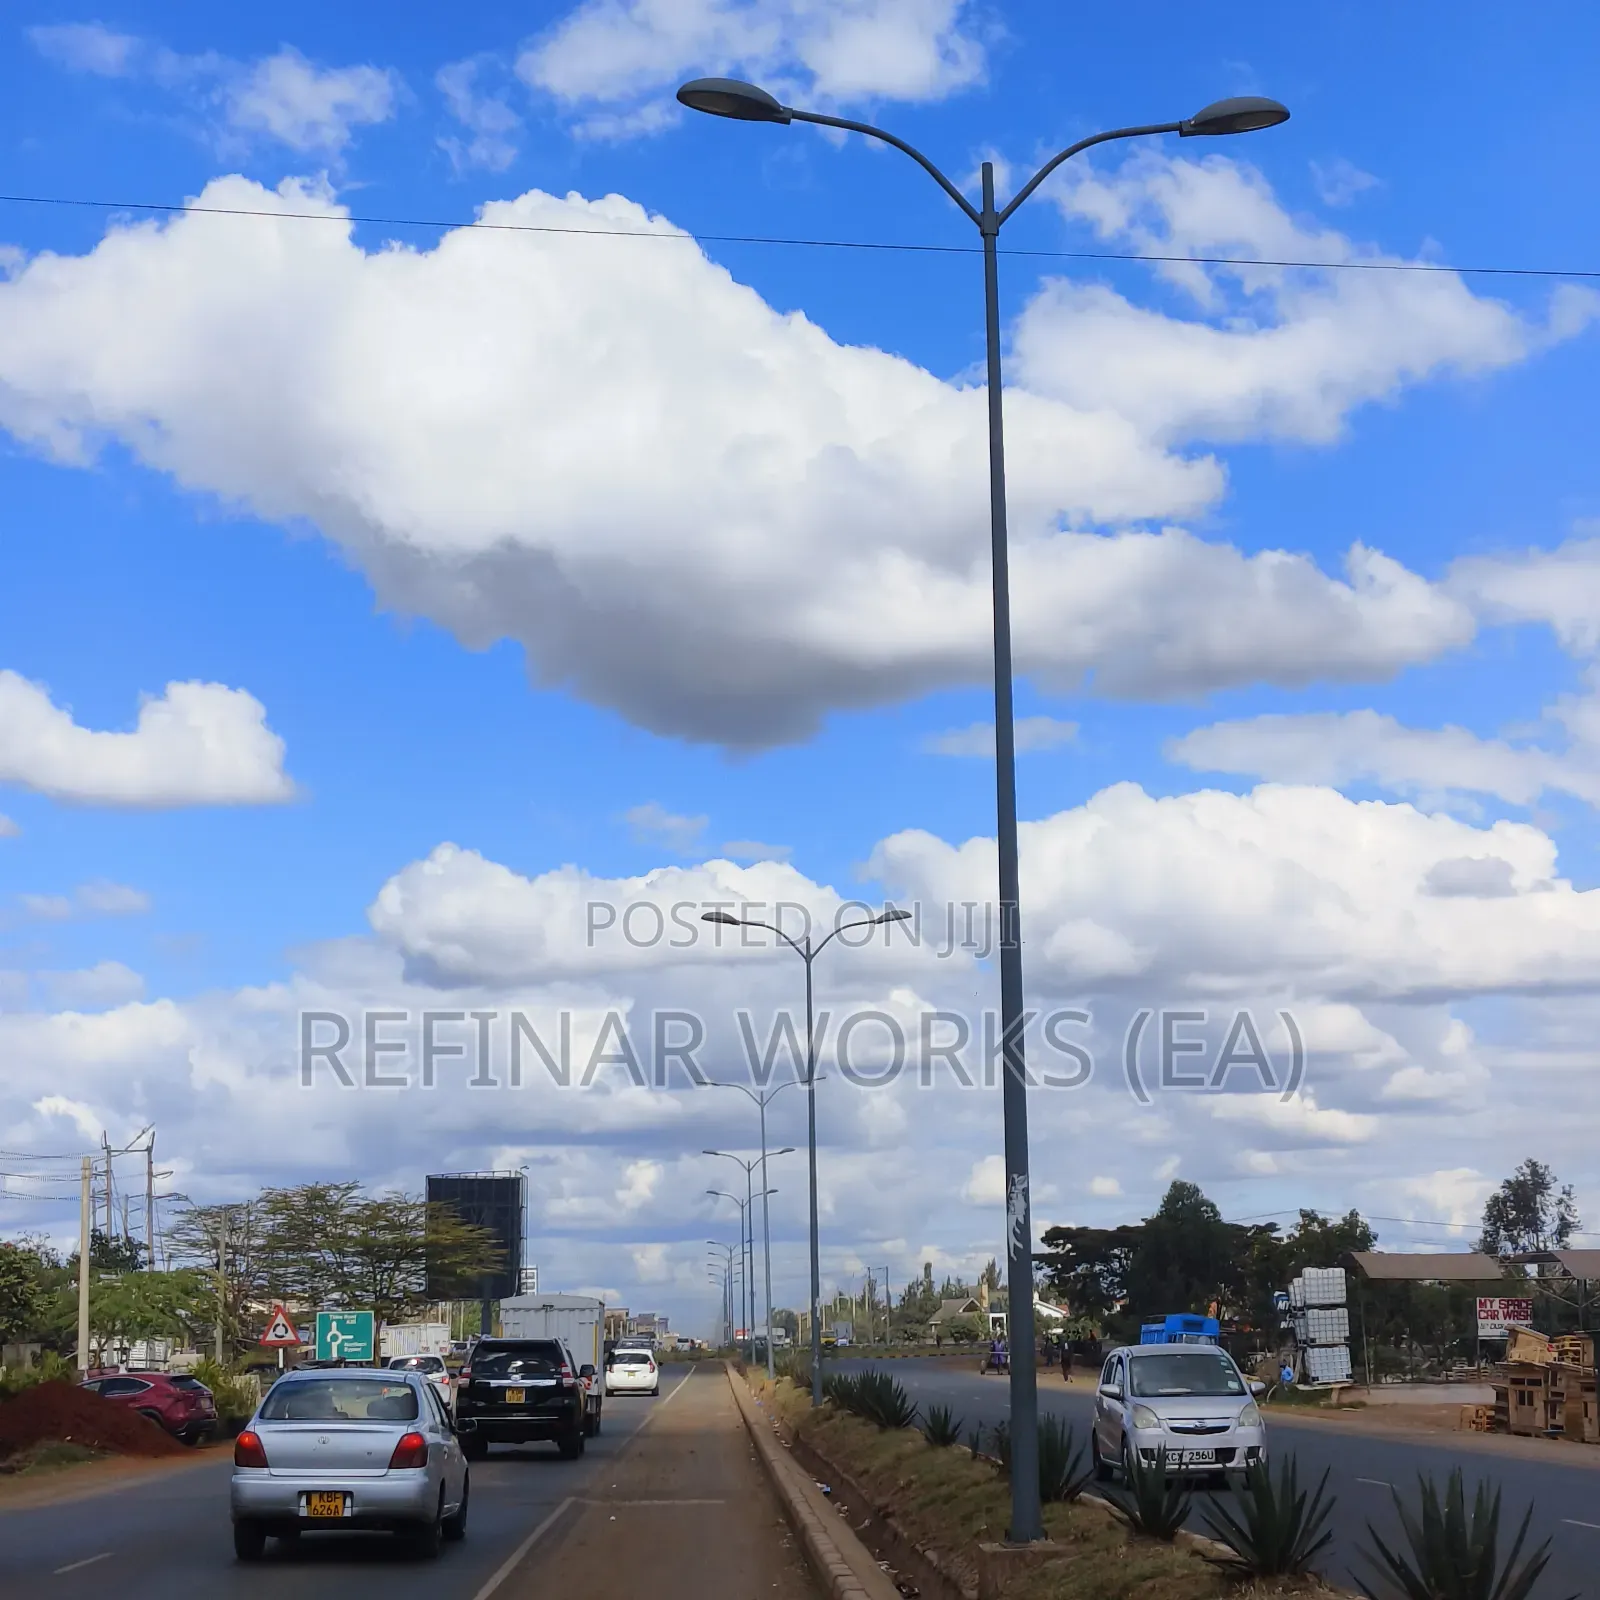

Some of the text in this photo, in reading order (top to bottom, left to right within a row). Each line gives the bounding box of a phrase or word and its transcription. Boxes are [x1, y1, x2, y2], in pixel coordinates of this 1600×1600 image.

[1479, 1298, 1532, 1310] MY SPACE
[1478, 1309, 1532, 1321] CAR WASH
[313, 1504, 340, 1516] 626A
